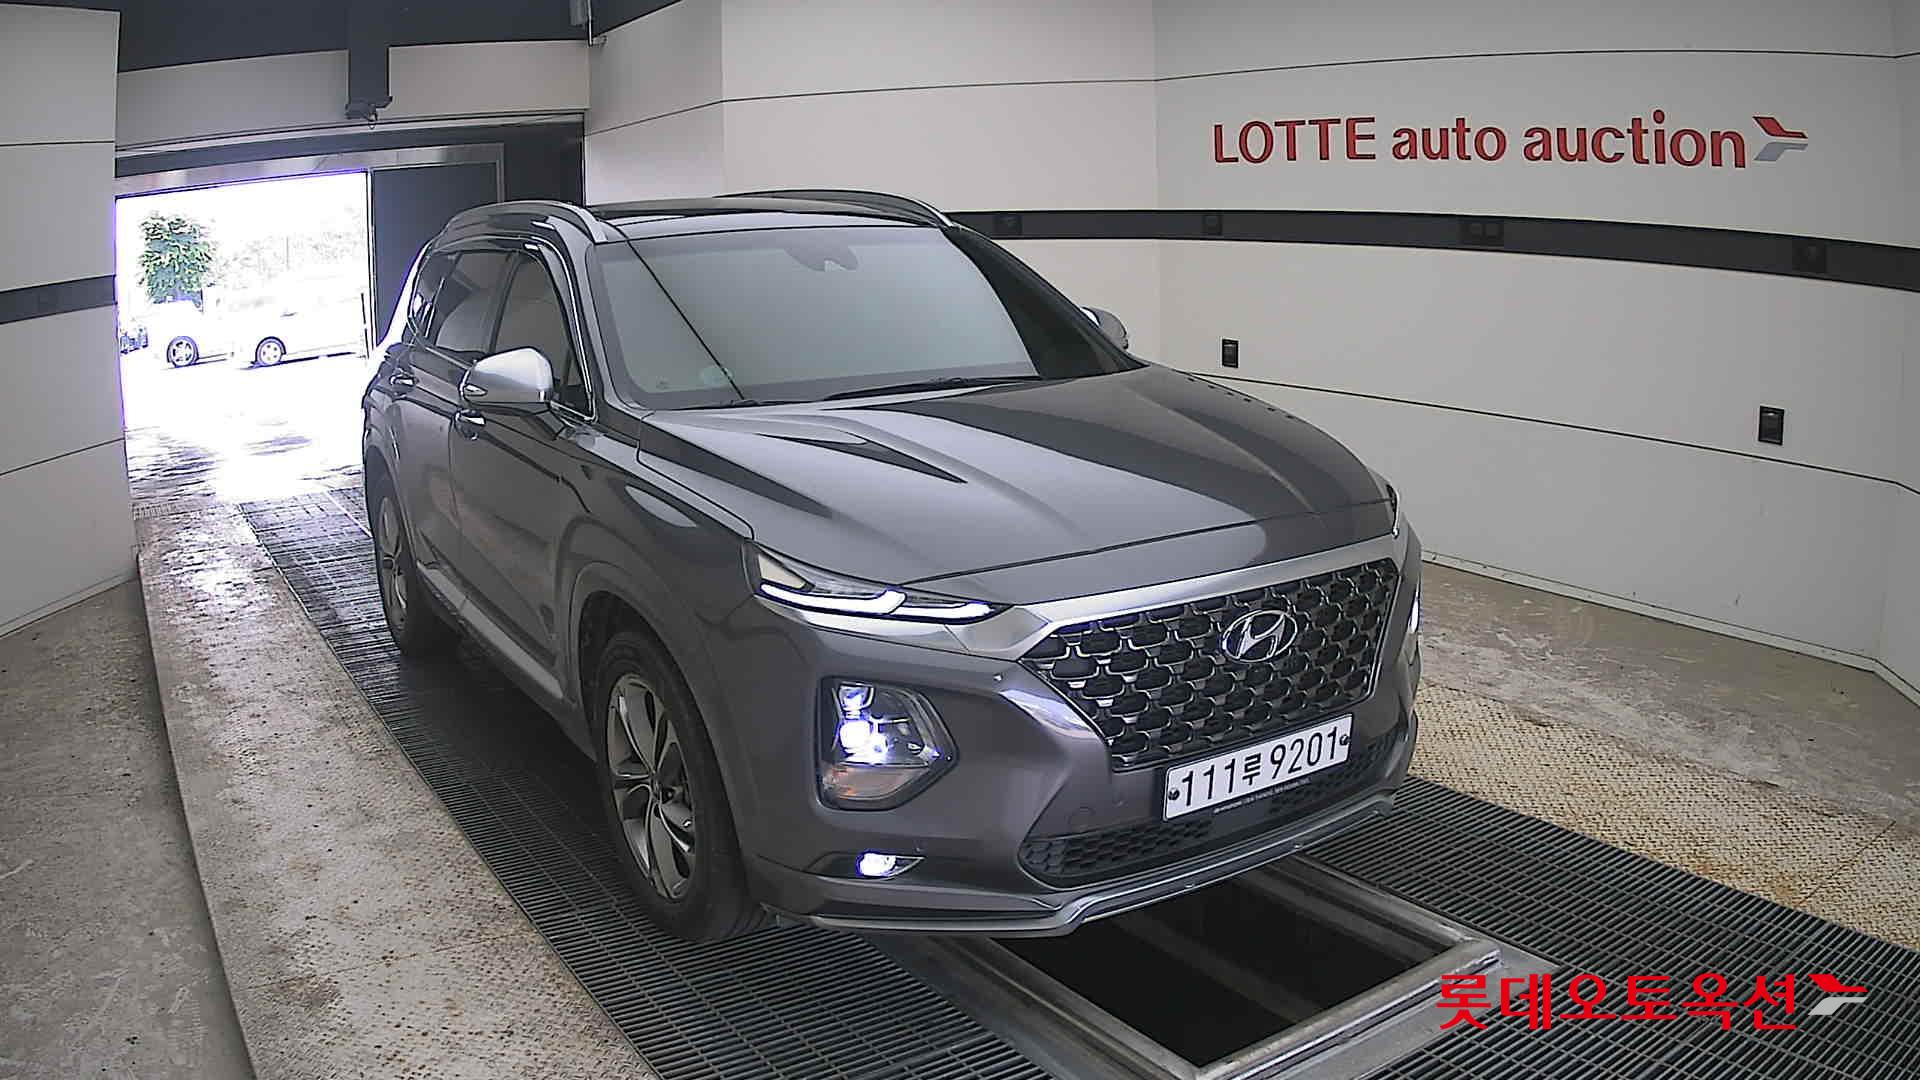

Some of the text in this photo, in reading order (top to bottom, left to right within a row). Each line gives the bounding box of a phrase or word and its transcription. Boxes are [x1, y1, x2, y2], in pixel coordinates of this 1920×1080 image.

[1213, 109, 1746, 168] LOTTE auto auction
